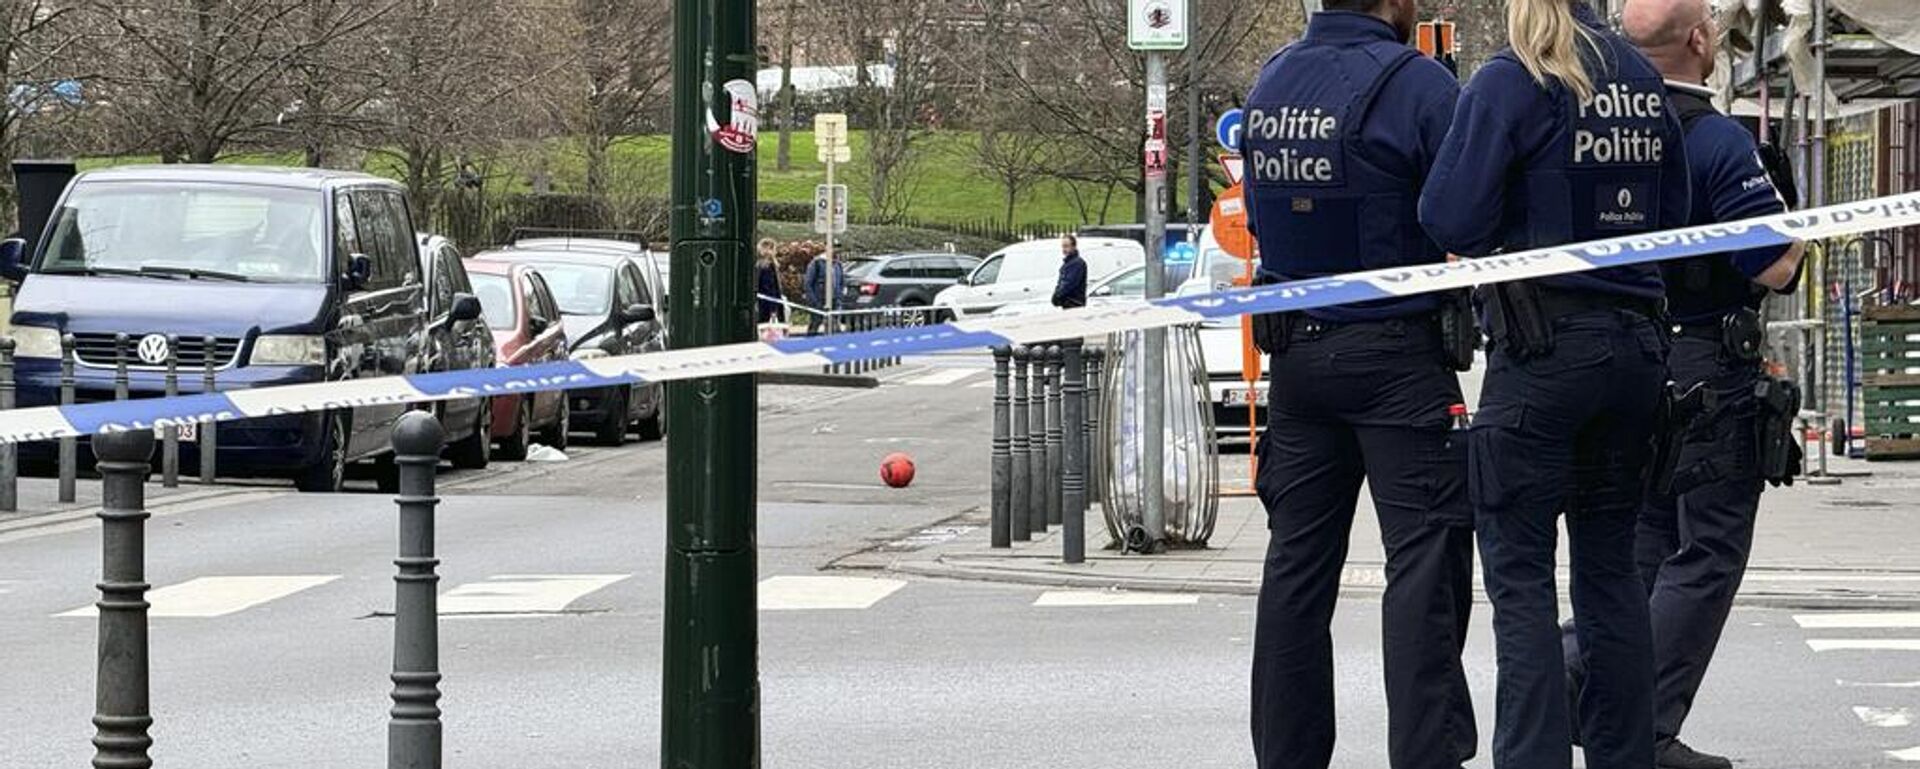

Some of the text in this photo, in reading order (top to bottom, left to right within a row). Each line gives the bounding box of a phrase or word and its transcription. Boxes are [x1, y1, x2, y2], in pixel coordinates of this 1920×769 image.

[1578, 83, 1661, 118] Police
[1248, 106, 1336, 139] Politie
[1574, 126, 1662, 163] Politie
[1253, 148, 1332, 181] Police
